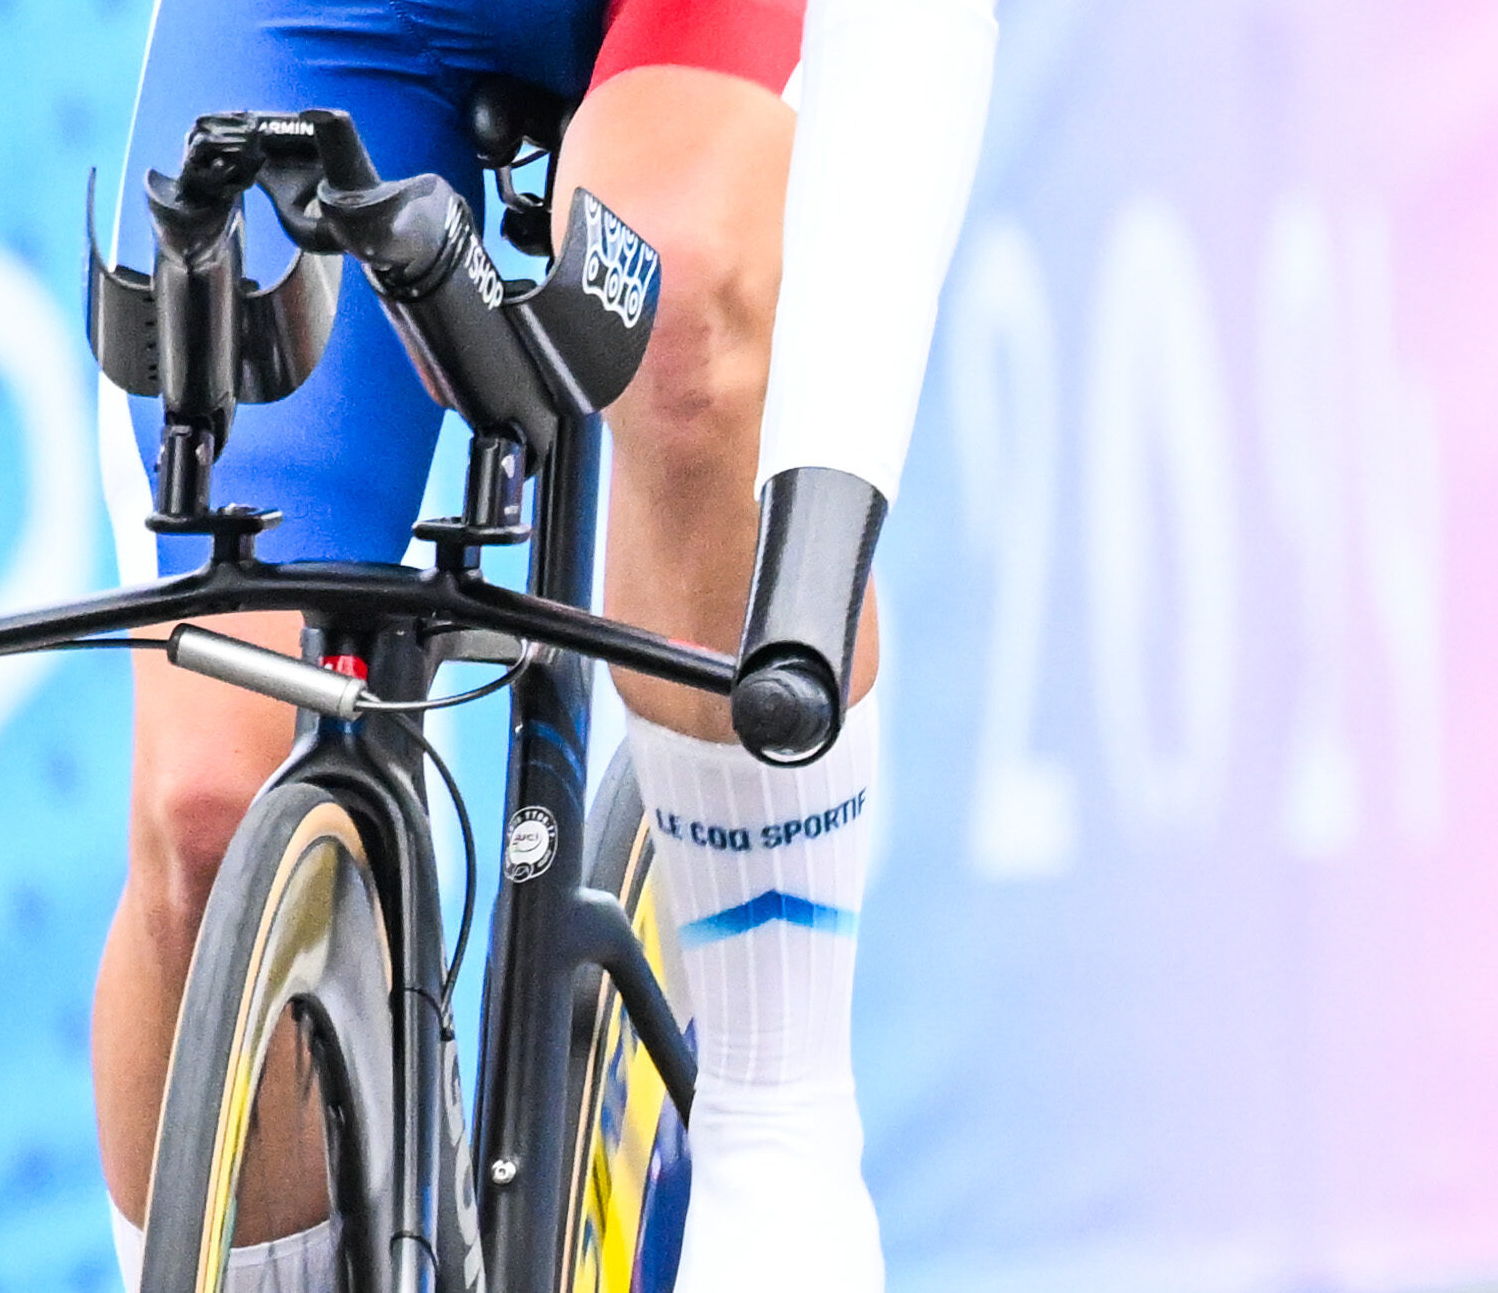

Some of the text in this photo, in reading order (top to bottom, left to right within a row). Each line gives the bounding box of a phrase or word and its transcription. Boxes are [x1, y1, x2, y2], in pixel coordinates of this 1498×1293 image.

[942, 189, 1450, 885] 2024
[655, 785, 867, 852] LE COQ SPORTIF
